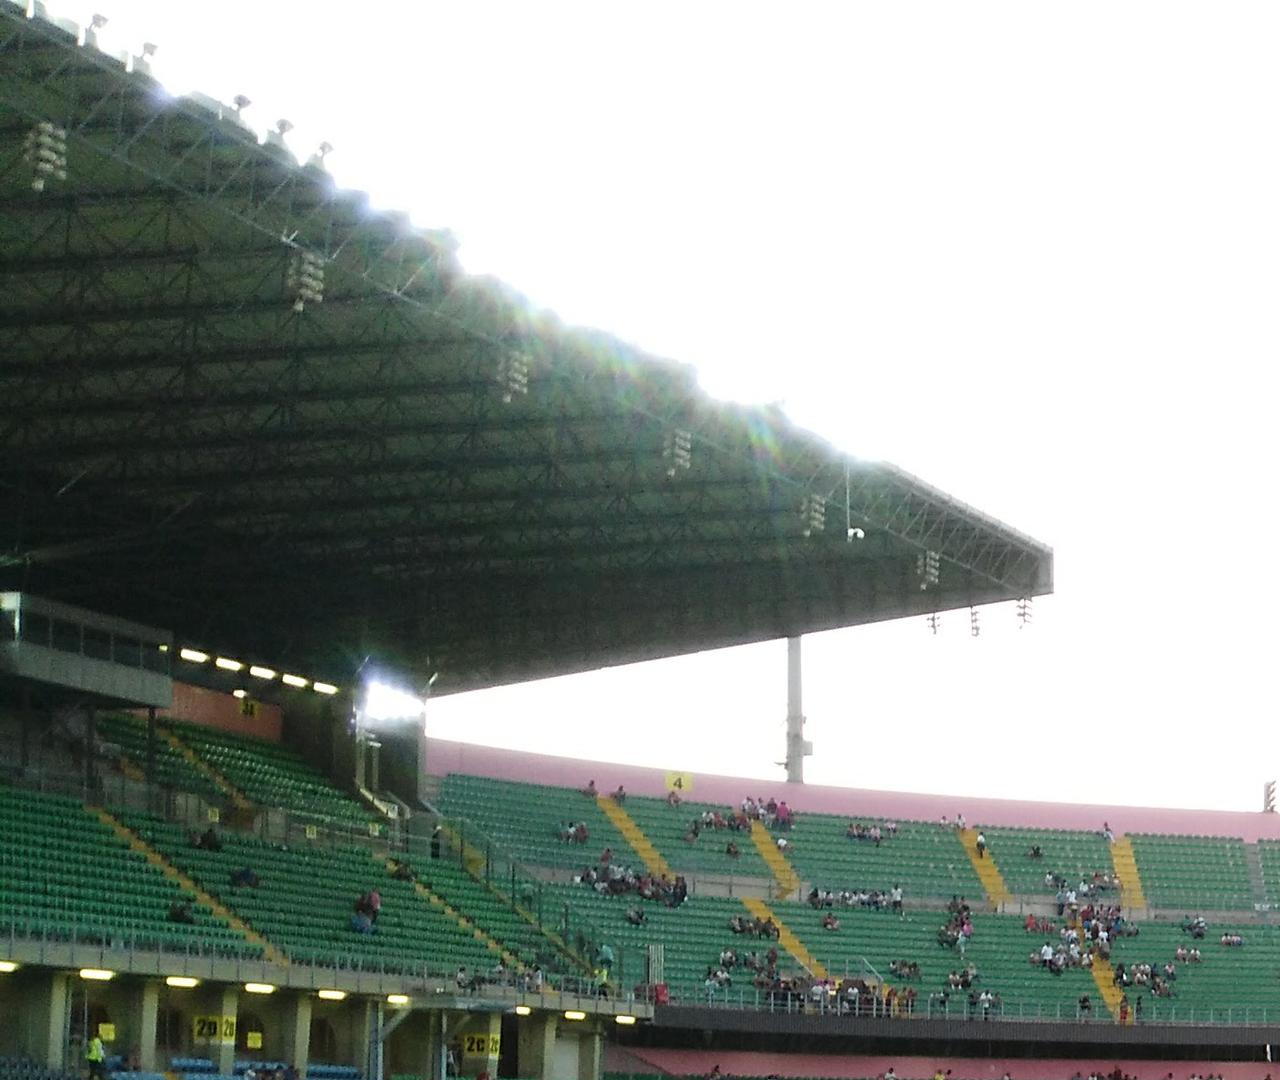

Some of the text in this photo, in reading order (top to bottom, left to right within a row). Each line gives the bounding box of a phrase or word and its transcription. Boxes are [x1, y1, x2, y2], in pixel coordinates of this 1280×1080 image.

[673, 778, 682, 790] 4
[196, 1019, 218, 1037] 2D
[467, 1036, 486, 1052] 2C
